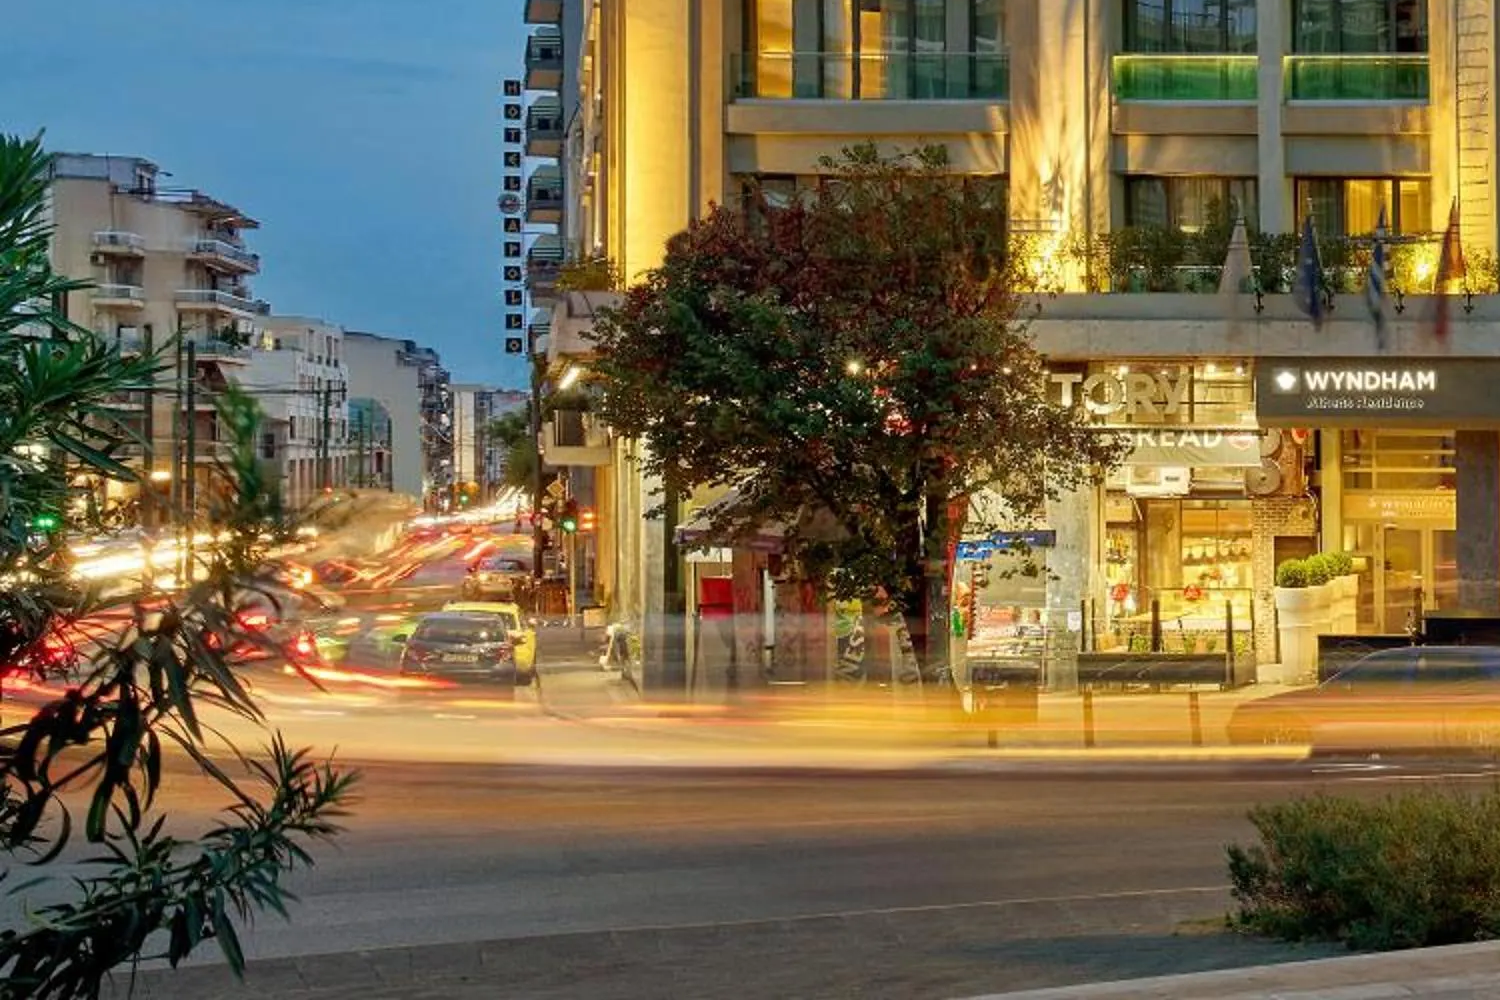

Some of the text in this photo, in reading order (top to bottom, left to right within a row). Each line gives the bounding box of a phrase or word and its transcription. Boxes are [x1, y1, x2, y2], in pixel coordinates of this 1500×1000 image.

[505, 81, 521, 351] HOTEL APOLLO
[1304, 370, 1436, 391] WYNDHAM
[1118, 430, 1223, 448] READ
